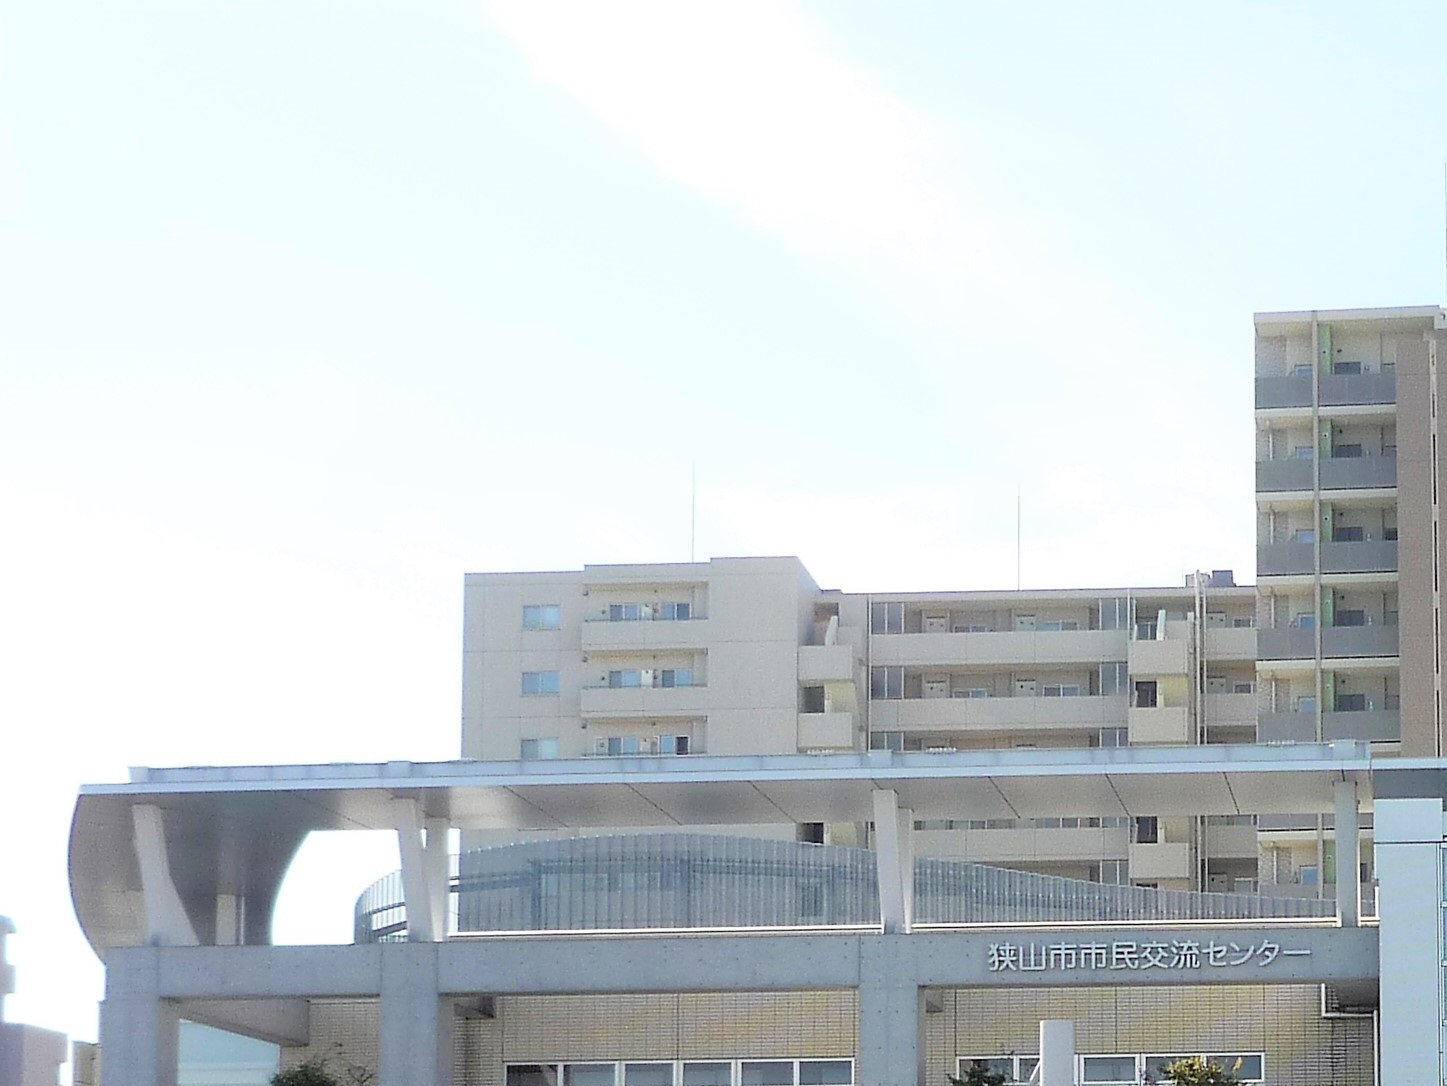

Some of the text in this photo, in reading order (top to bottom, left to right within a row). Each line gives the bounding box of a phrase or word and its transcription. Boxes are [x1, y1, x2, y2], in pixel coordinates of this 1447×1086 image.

[988, 940, 1312, 972] 狭山市市民交流センター
